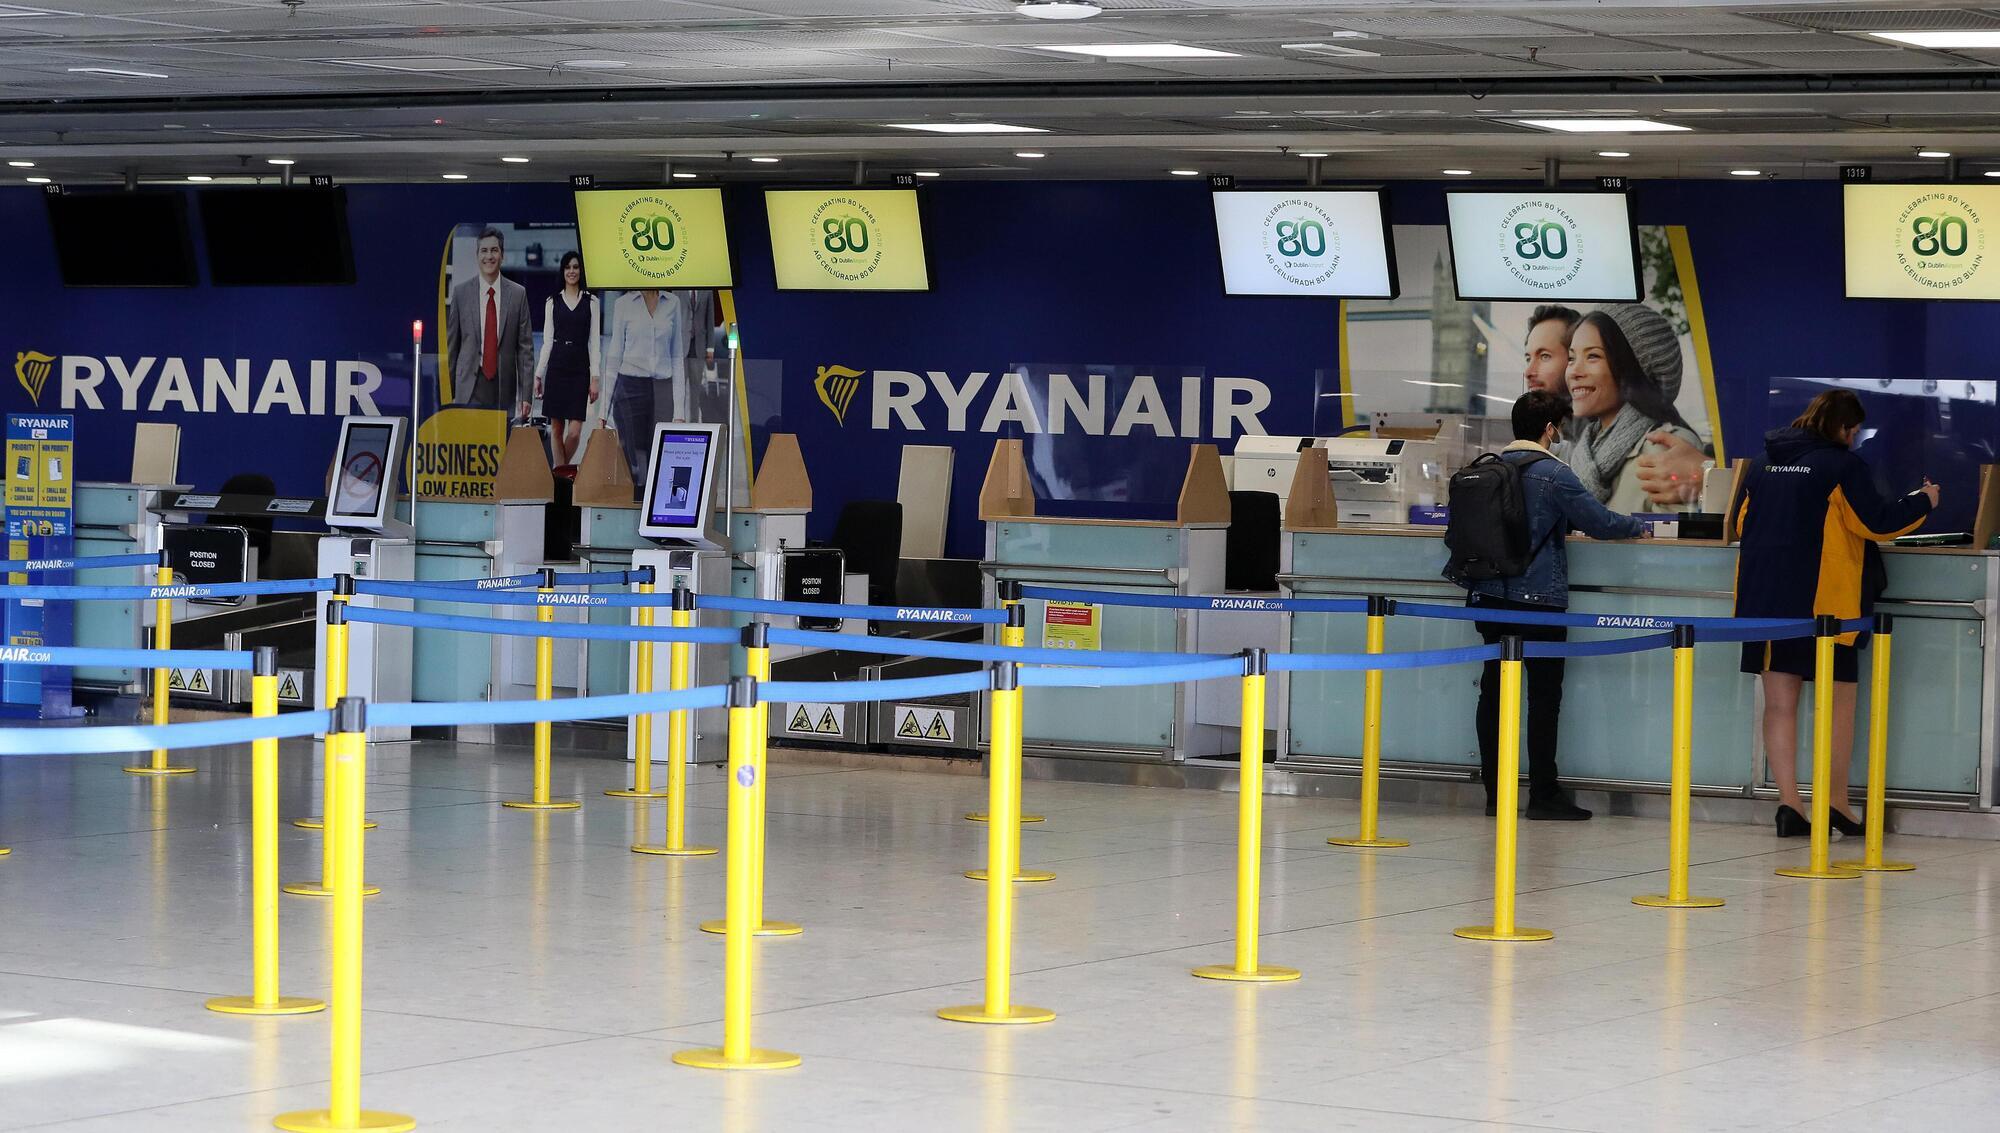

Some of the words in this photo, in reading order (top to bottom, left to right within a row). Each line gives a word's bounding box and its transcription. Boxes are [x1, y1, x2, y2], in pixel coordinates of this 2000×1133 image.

[313, 176, 329, 187] 1314
[575, 177, 590, 186] 1315
[896, 176, 913, 185] 1316
[1212, 177, 1229, 186] 1317
[1602, 178, 1621, 188] 1318
[1846, 168, 1865, 178] 1319
[46, 184, 60, 194] 1313
[619, 196, 654, 224] CELEBRATING
[654, 197, 664, 206] 80
[663, 202, 682, 223] YEARS
[811, 197, 847, 225] CELEBRATING
[847, 198, 857, 207] 80
[857, 203, 876, 225] YEARS
[1263, 199, 1302, 227] CELEBRATING
[1302, 200, 1313, 209] 80
[1314, 205, 1335, 228] YEARS
[1501, 200, 1543, 230] CELEBRATING
[1544, 201, 1555, 211] 80
[1556, 207, 1577, 230] YEARS
[1898, 193, 1945, 224] CELEBRATING
[1947, 194, 1958, 204] 80
[1959, 200, 1980, 224] YEARS
[630, 216, 675, 251] 80
[823, 217, 869, 253] 80
[1275, 219, 1326, 257] 80
[1514, 222, 1568, 260] 80
[1912, 216, 1968, 257] 80
[621, 247, 629, 259] AG
[666, 268, 675, 277] 80
[674, 248, 688, 271] BLIAIN
[813, 249, 822, 261] AG
[859, 270, 869, 280] 80
[867, 250, 882, 273] BLIAIN
[1265, 252, 1275, 265] AG
[1315, 274, 1326, 286] 80
[1324, 255, 1341, 279] BLIAIN
[1502, 255, 1512, 268] AG
[1556, 277, 1567, 288] 80
[1565, 257, 1583, 282] BLIAIN
[1896, 251, 1907, 265] AG
[1951, 277, 1963, 287] 80
[1962, 254, 1983, 281] BLIAIN
[61, 355, 384, 417] RYANAIR
[871, 370, 1274, 439] RYANAIR
[18, 418, 69, 429] RYANAIR
[411, 442, 499, 477] BUSINESS
[1770, 465, 1811, 474] RYANAIR
[189, 550, 217, 560] POSITION
[191, 560, 216, 569] CLOSED
[801, 577, 822, 585] POSITION
[802, 587, 820, 595] CLOSED
